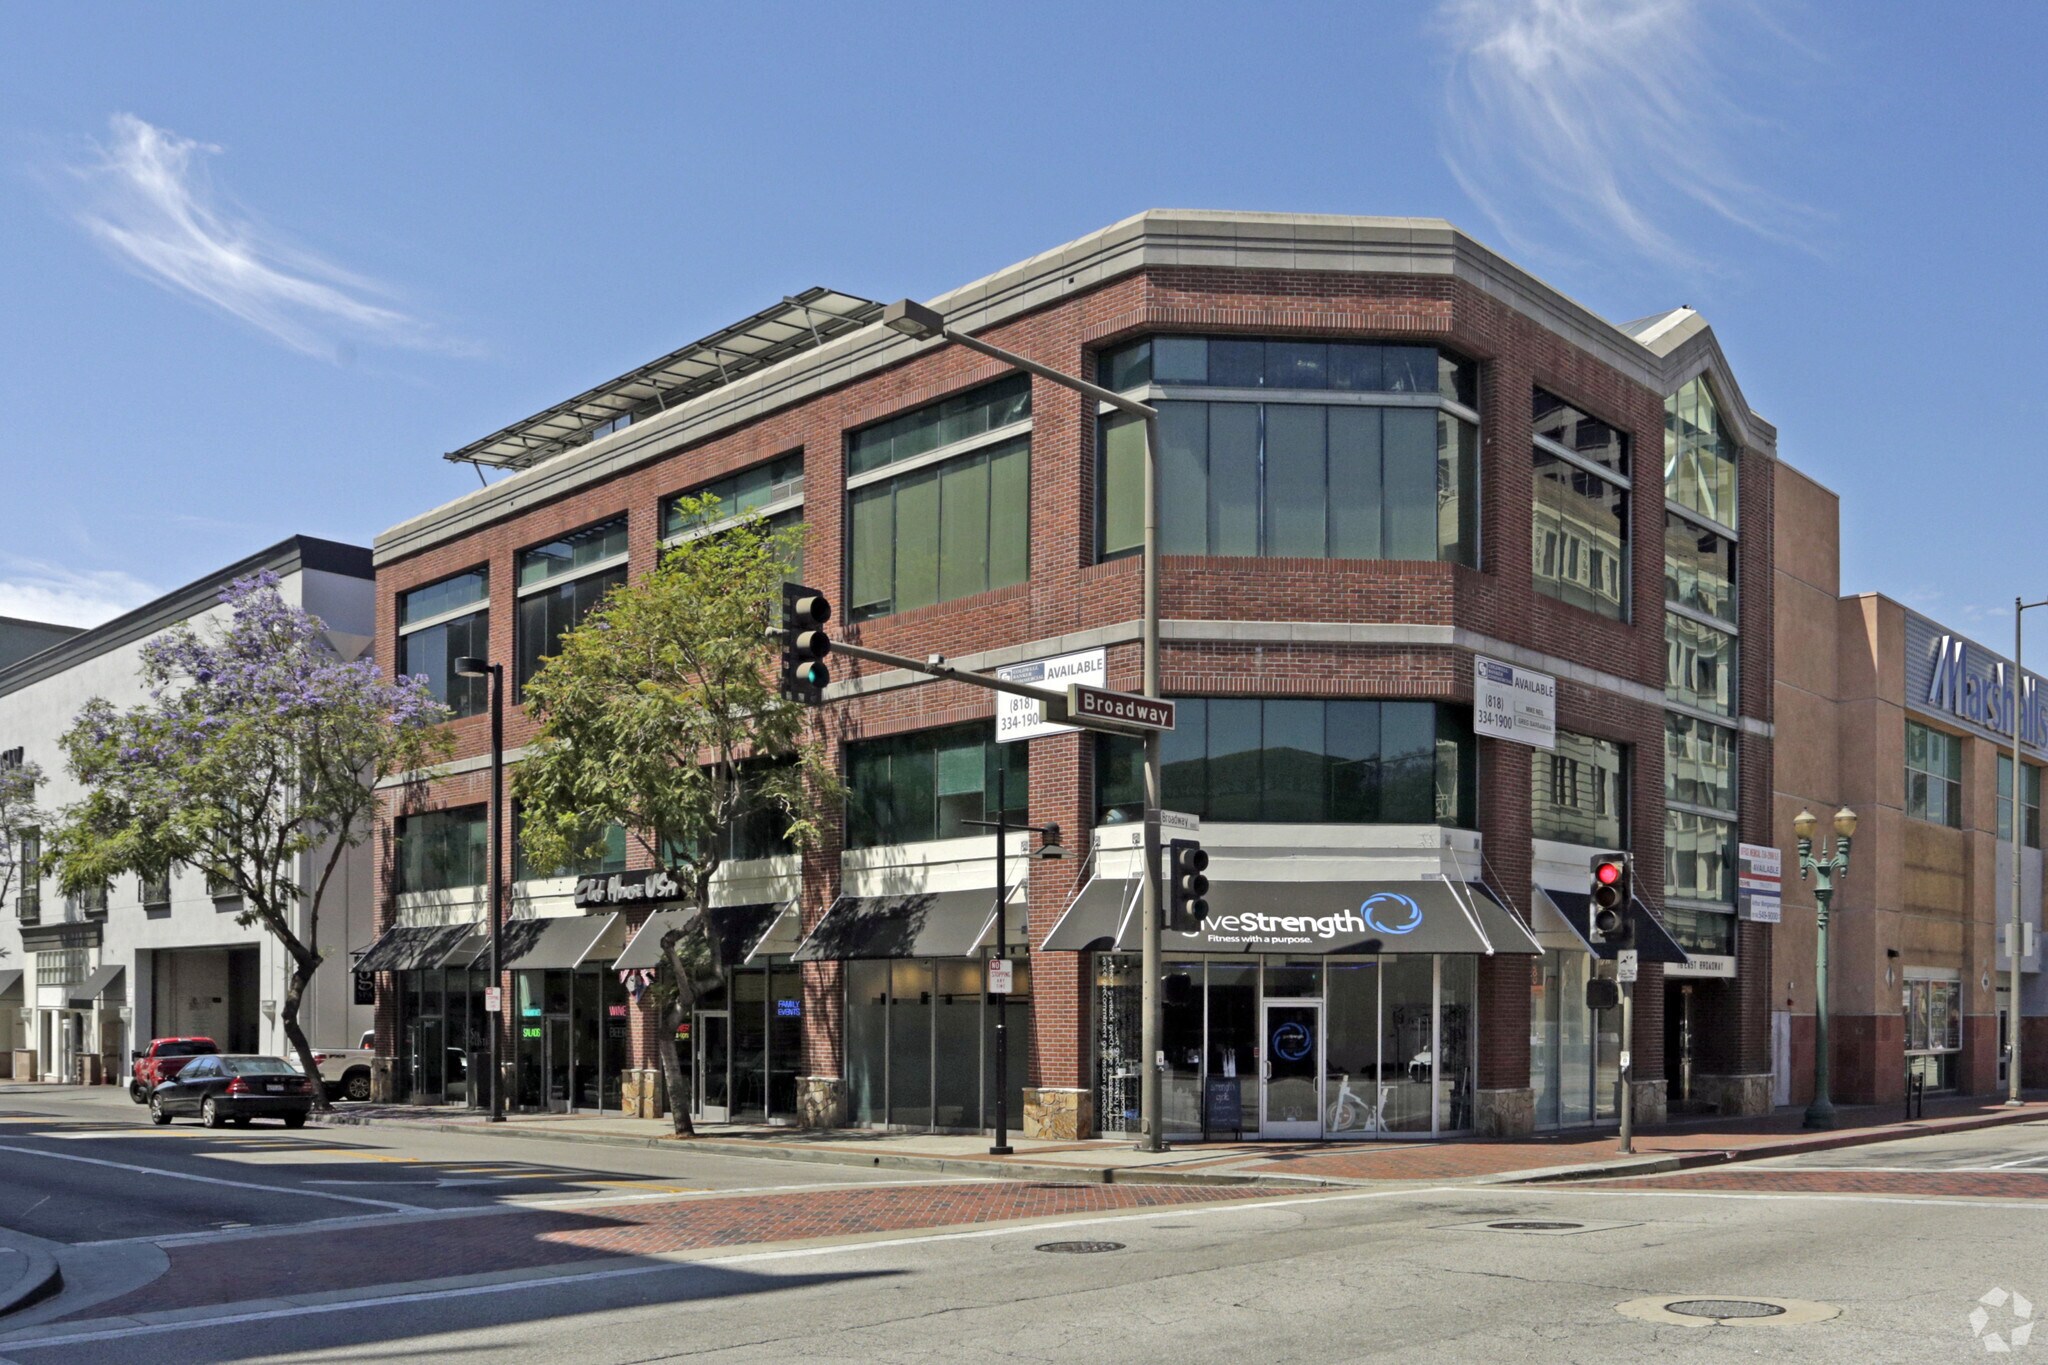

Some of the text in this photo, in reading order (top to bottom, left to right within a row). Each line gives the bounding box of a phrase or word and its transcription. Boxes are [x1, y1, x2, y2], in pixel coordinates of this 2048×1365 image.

[1047, 658, 1103, 680] AVAILABLE
[1514, 677, 1554, 698] AVAILABLE
[1010, 698, 1033, 713] (818)
[1084, 692, 1168, 726] Broadway
[1485, 693, 1504, 711] (818)
[1478, 709, 1512, 730] 334-1900
[1161, 811, 1188, 828] Broadway
[1182, 909, 1365, 938] iveStrength
[1208, 934, 1313, 945] Fitness with a purpose.
[991, 961, 1000, 969] NO
[608, 1005, 627, 1017] WINE
[777, 1000, 800, 1008] FAMILY
[777, 1008, 801, 1016] EVENTS
